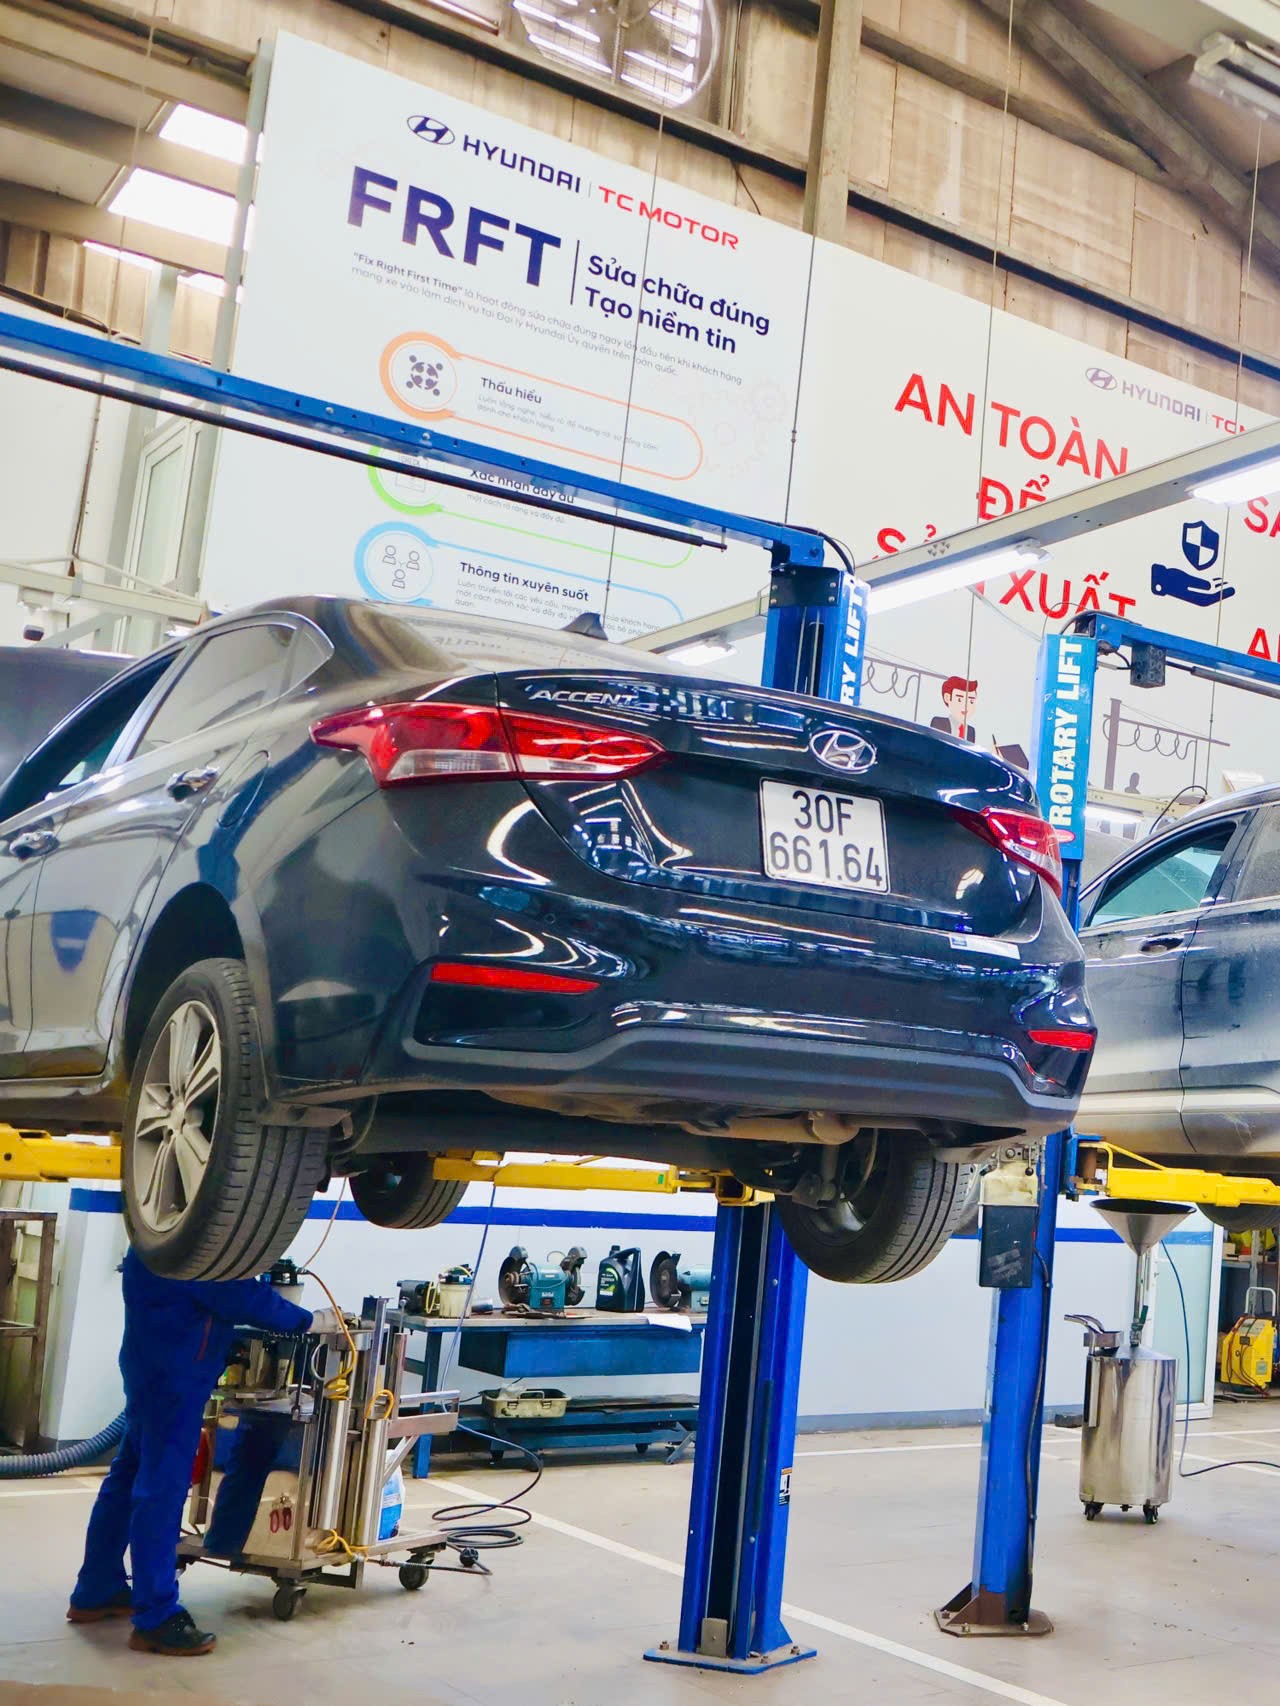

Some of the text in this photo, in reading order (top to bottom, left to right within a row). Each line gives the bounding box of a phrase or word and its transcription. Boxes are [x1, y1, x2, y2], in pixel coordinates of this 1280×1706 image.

[464, 135, 582, 193] HYUNDAI
[347, 166, 562, 287] FRFT
[598, 186, 740, 250] TC MOTOR
[351, 266, 383, 284] mang
[384, 277, 398, 287] xe
[525, 320, 566, 341] Hyundai
[376, 260, 406, 278] Right
[407, 270, 430, 284] First
[598, 333, 622, 348] ngay
[585, 286, 737, 354] Tạo niềm tin
[587, 252, 771, 336] Sửa chữa đúng
[480, 376, 542, 404] Thấu hiểu
[1122, 381, 1201, 422] HYUNDAI
[894, 373, 1129, 479] AN TOÀN
[459, 561, 589, 602] Thông tin xuyên suốt
[845, 588, 863, 658] LIFT
[529, 689, 639, 706] ACCENT
[1049, 637, 1082, 827] ROTARY LIFT
[791, 789, 855, 836] 30F
[770, 833, 883, 887] 661.64
